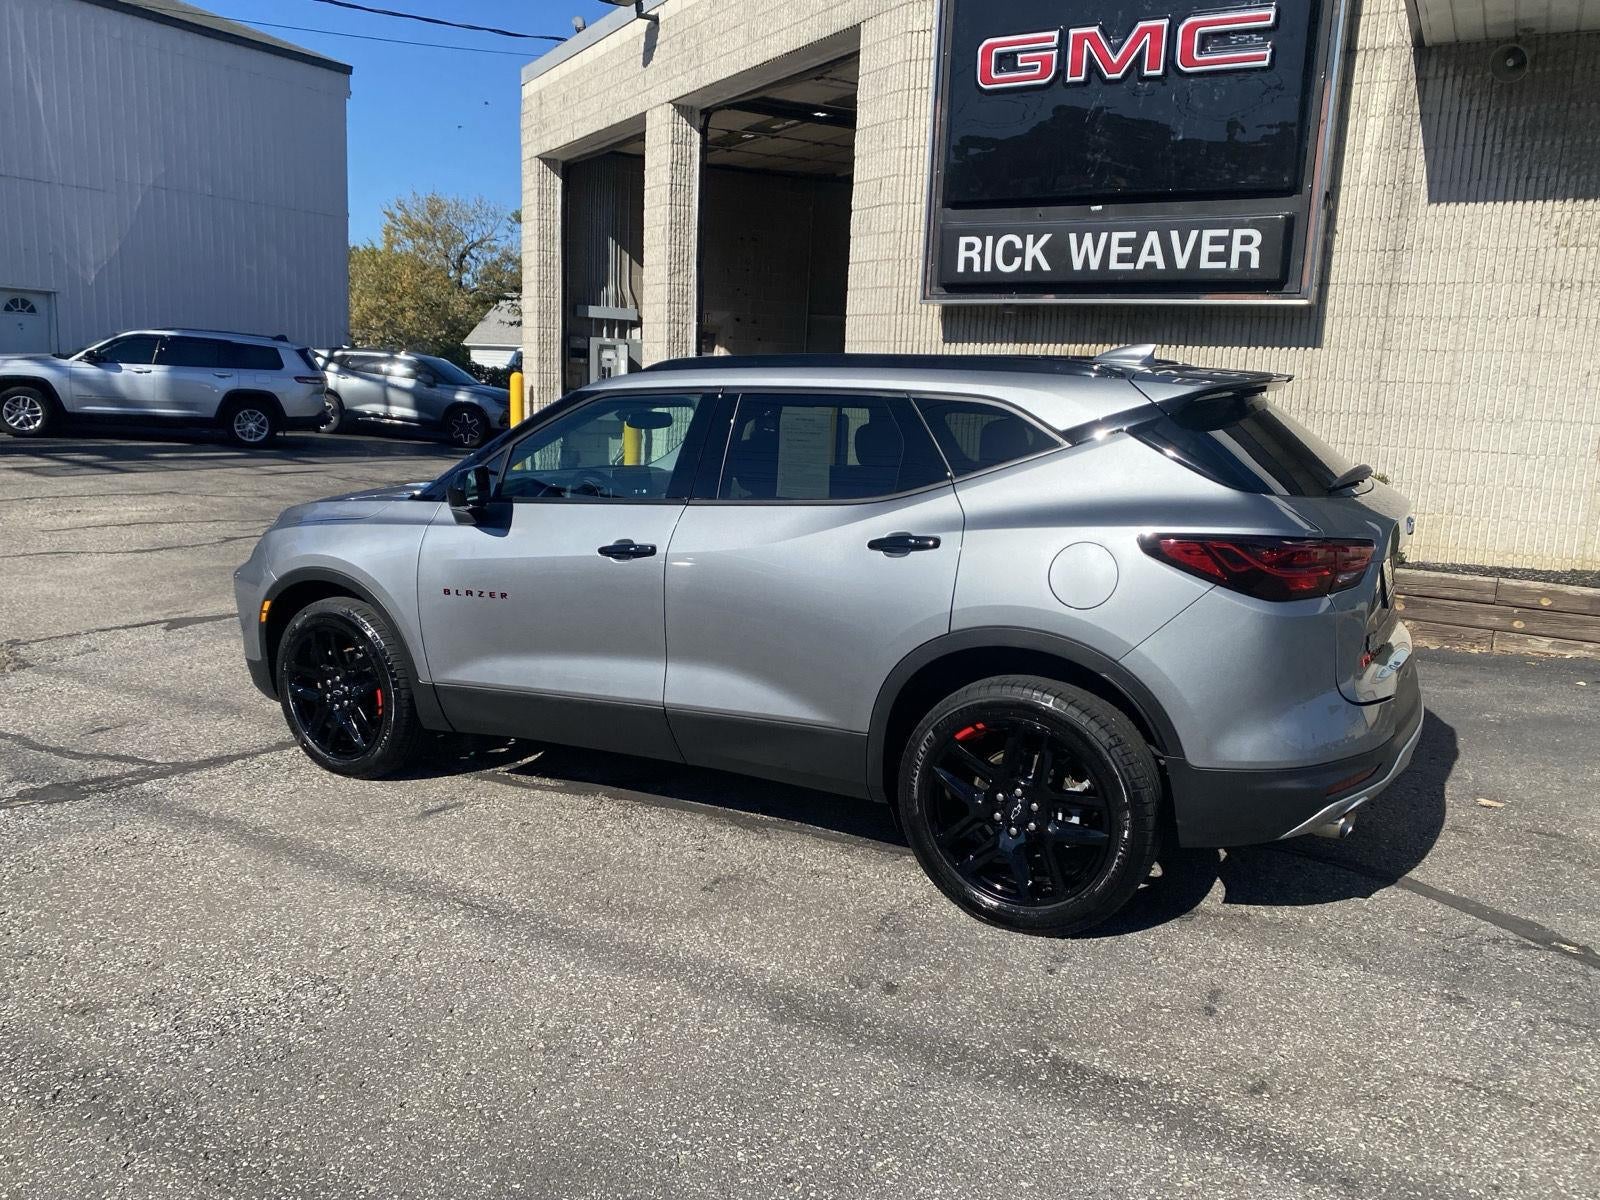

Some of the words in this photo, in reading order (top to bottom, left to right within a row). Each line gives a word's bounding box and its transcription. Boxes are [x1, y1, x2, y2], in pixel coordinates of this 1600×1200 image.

[976, 2, 1277, 90] GMC
[956, 232, 1052, 273] RICK
[1068, 228, 1263, 271] WEAVER
[443, 588, 509, 600] BLAZER
